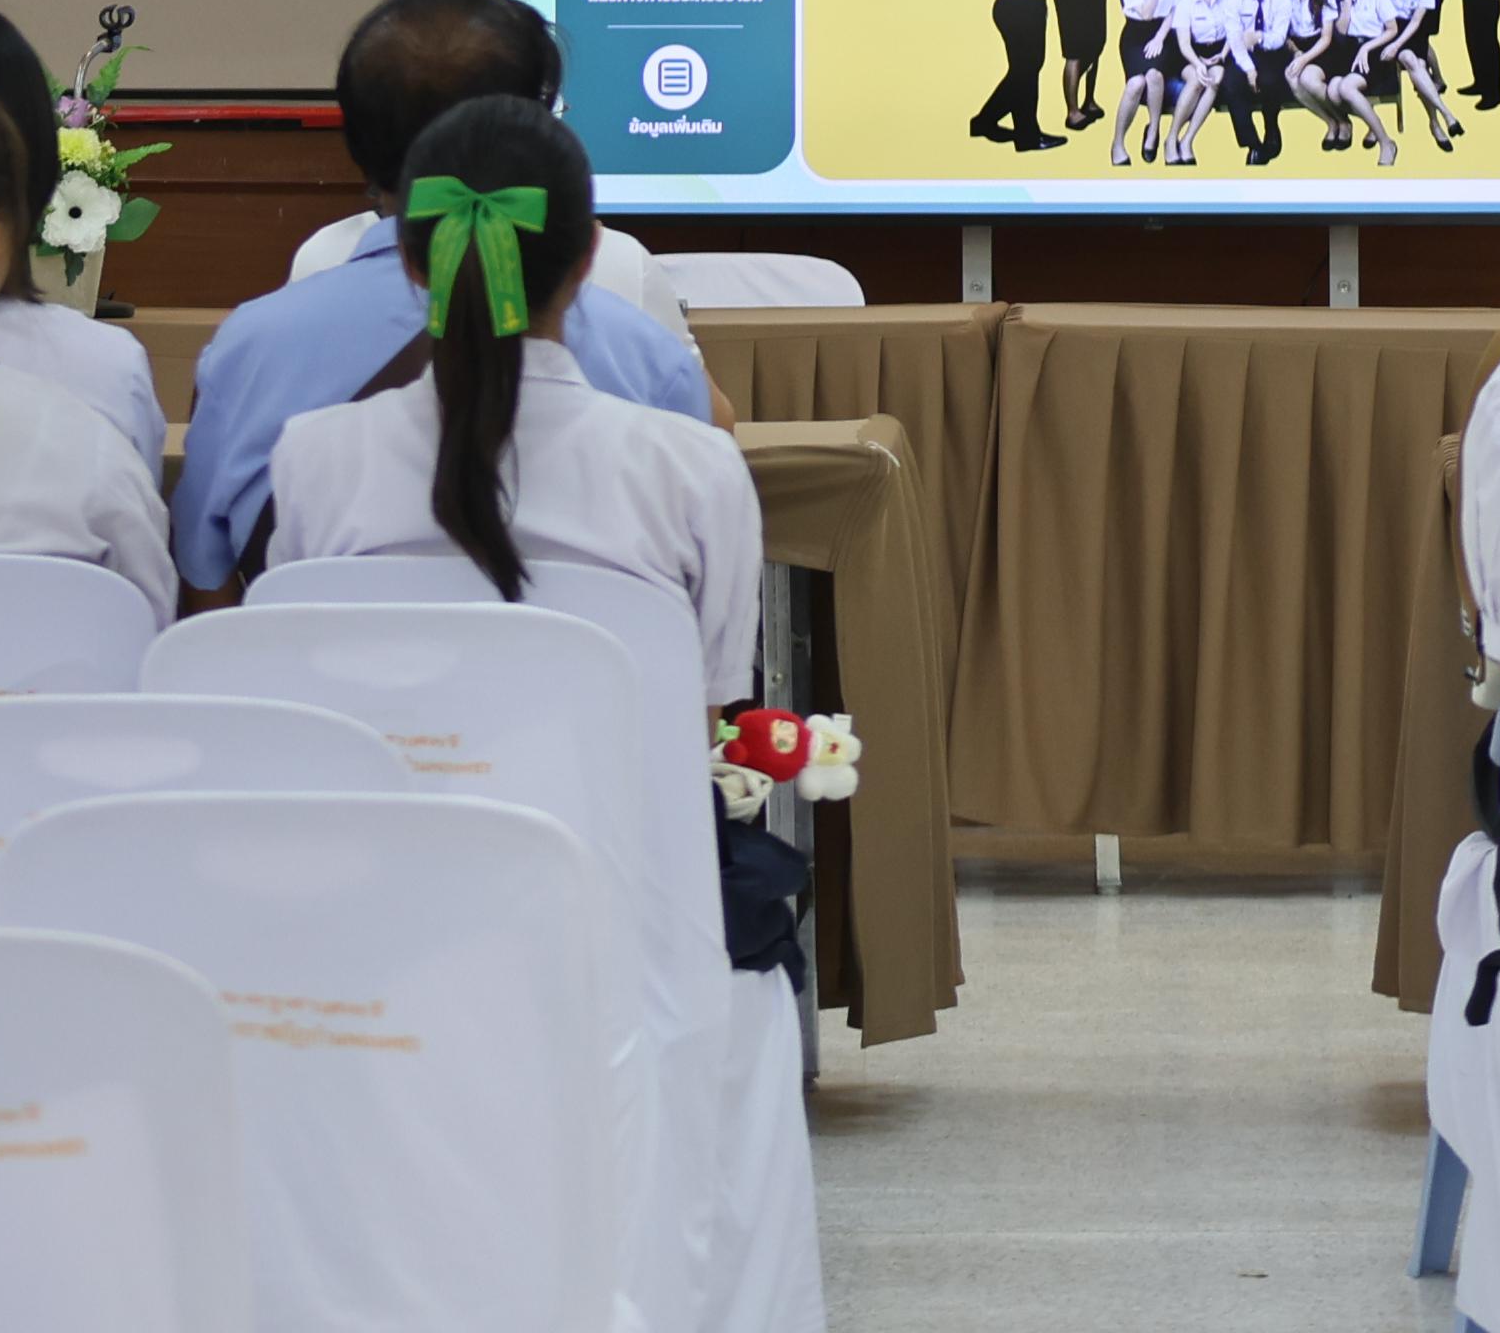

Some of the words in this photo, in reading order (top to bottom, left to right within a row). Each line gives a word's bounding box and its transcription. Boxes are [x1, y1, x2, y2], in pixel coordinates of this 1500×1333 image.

[628, 114, 723, 138] ข้อมูลเพิ่มเติม
